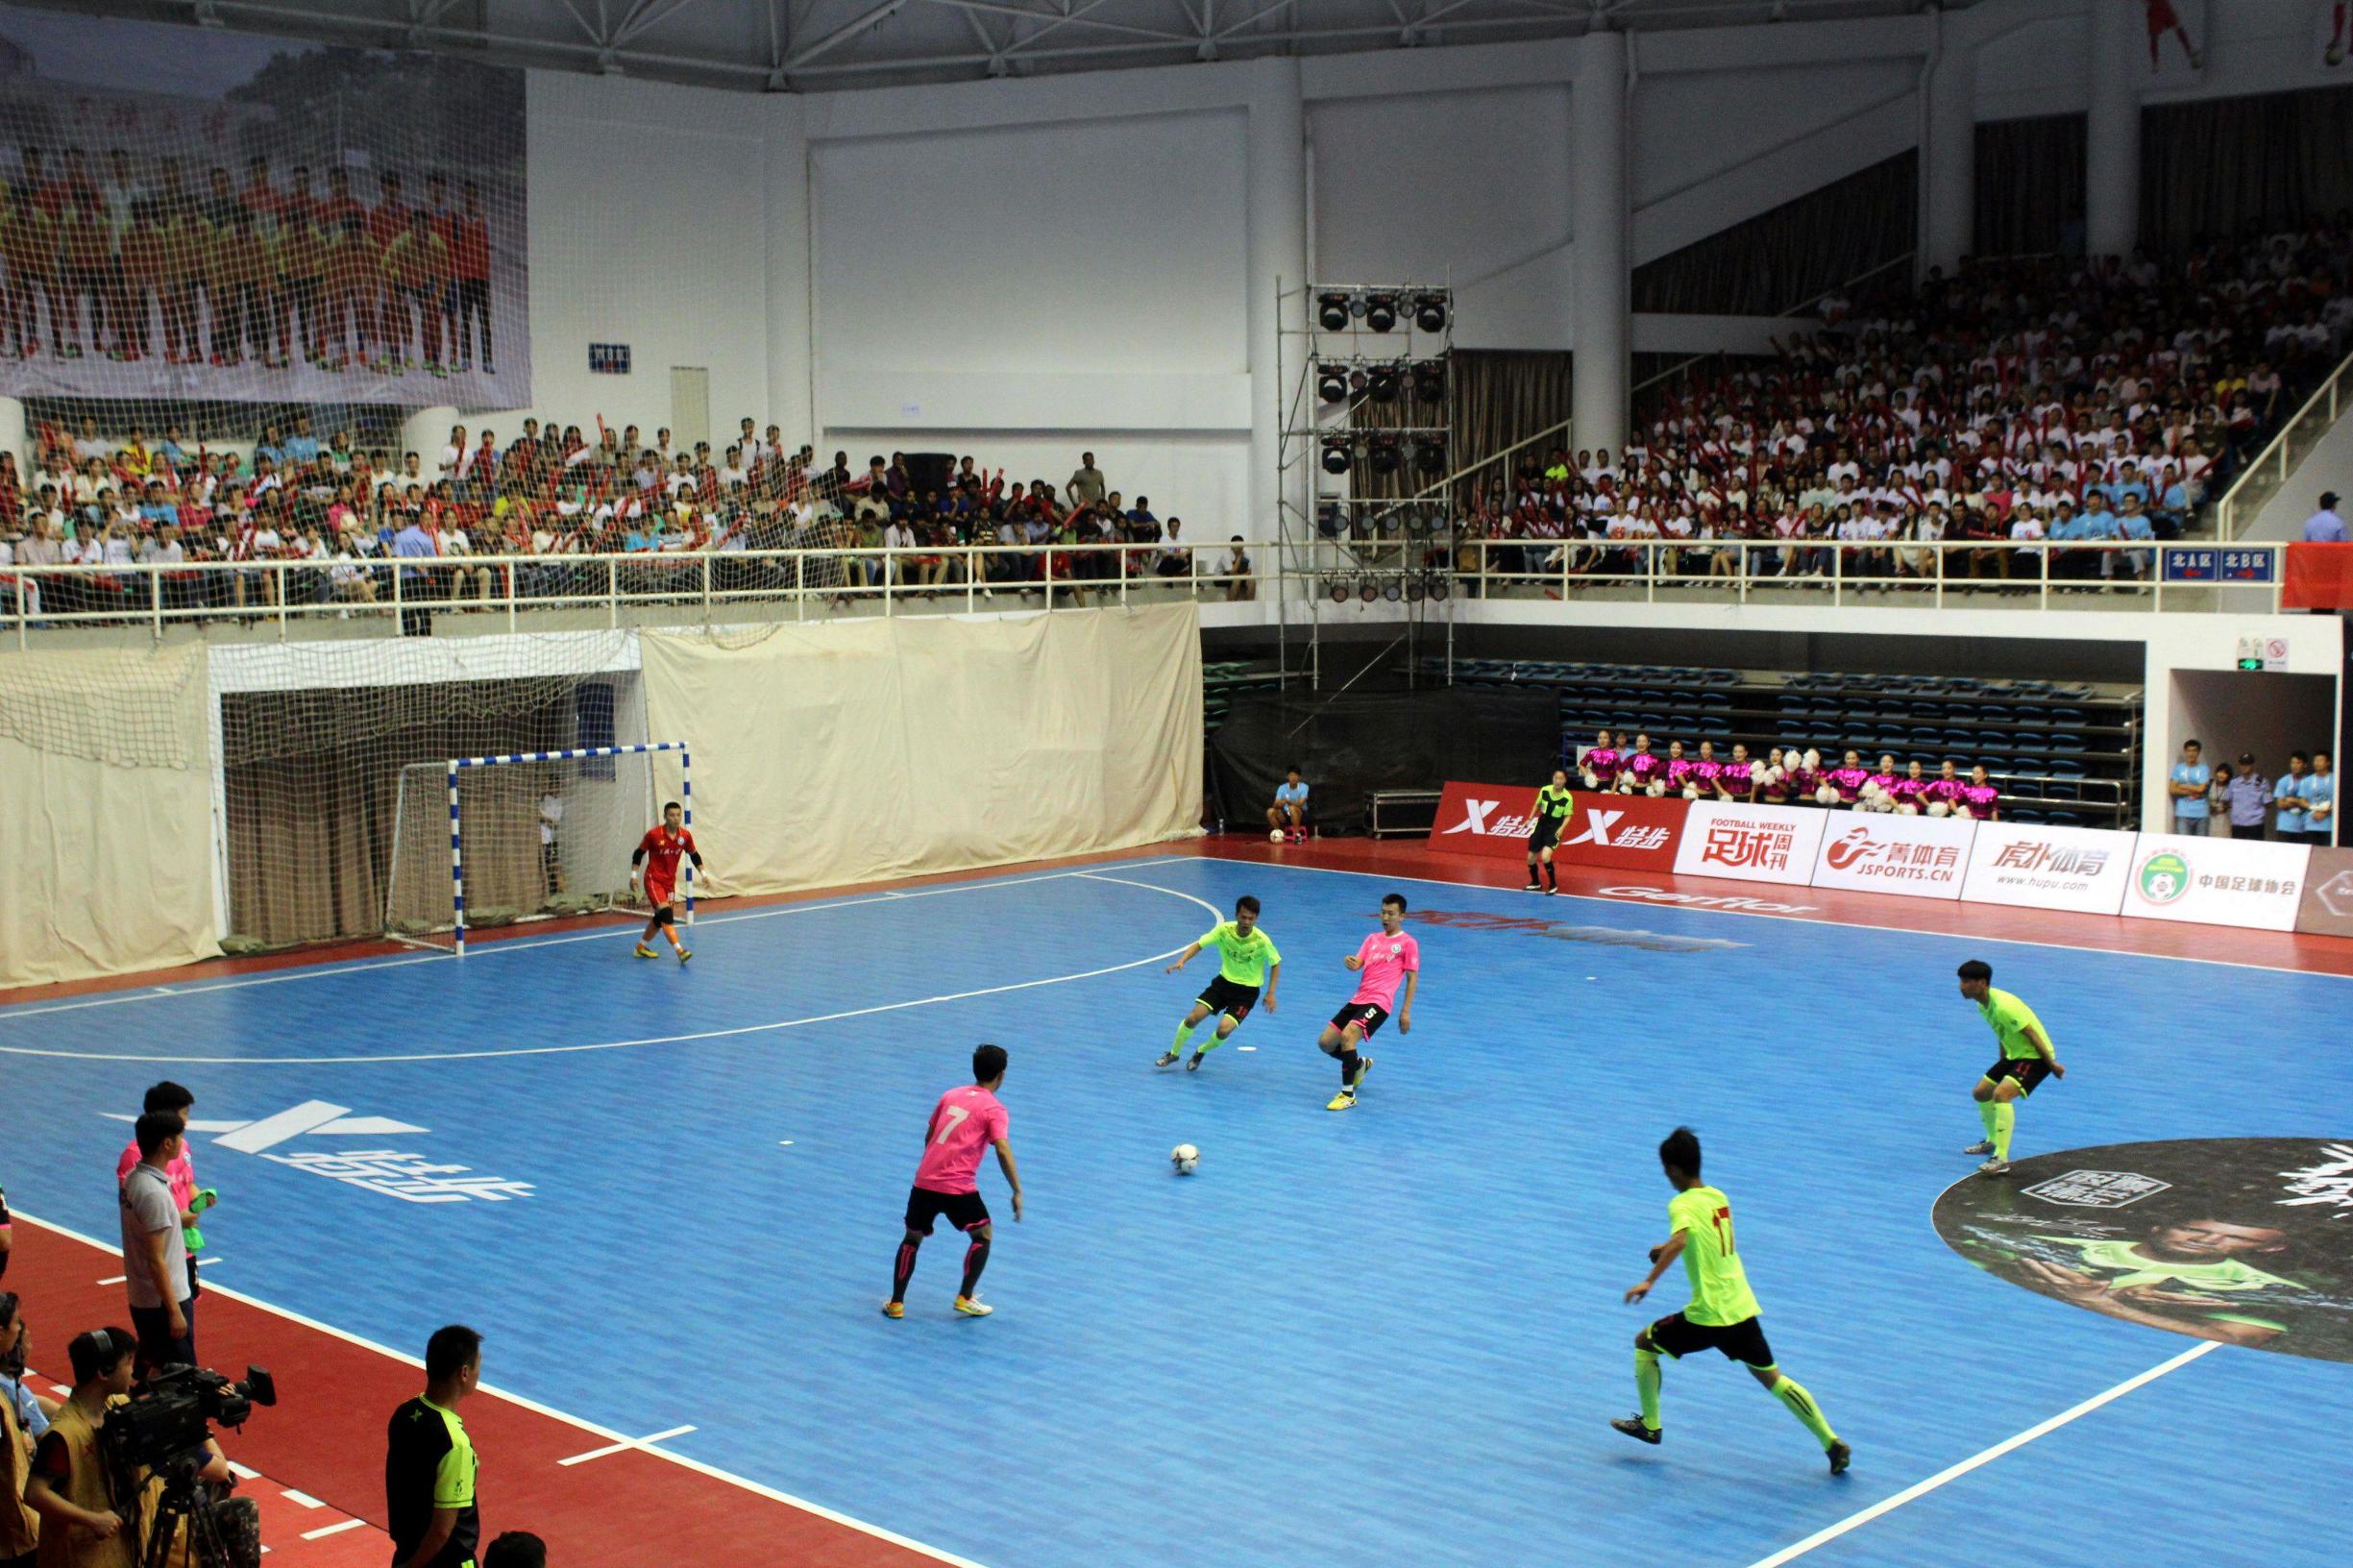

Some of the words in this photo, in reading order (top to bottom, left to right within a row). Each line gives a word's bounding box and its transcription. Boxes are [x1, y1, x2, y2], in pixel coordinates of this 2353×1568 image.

[1711, 819, 1756, 829] FOOTBALL
[1759, 821, 1797, 832] WEEKLY
[1610, 825, 1670, 849] 特步
[1857, 864, 1953, 882] JSPORTS.CN
[1997, 875, 2090, 892] www.hupu.com
[2198, 874, 2295, 895] 中国足球协会
[1599, 886, 1820, 914] Gerflor
[1365, 1007, 1377, 1019] 5
[937, 1105, 969, 1145] 7
[257, 1150, 538, 1203] 特步
[1713, 1207, 1734, 1258] 17
